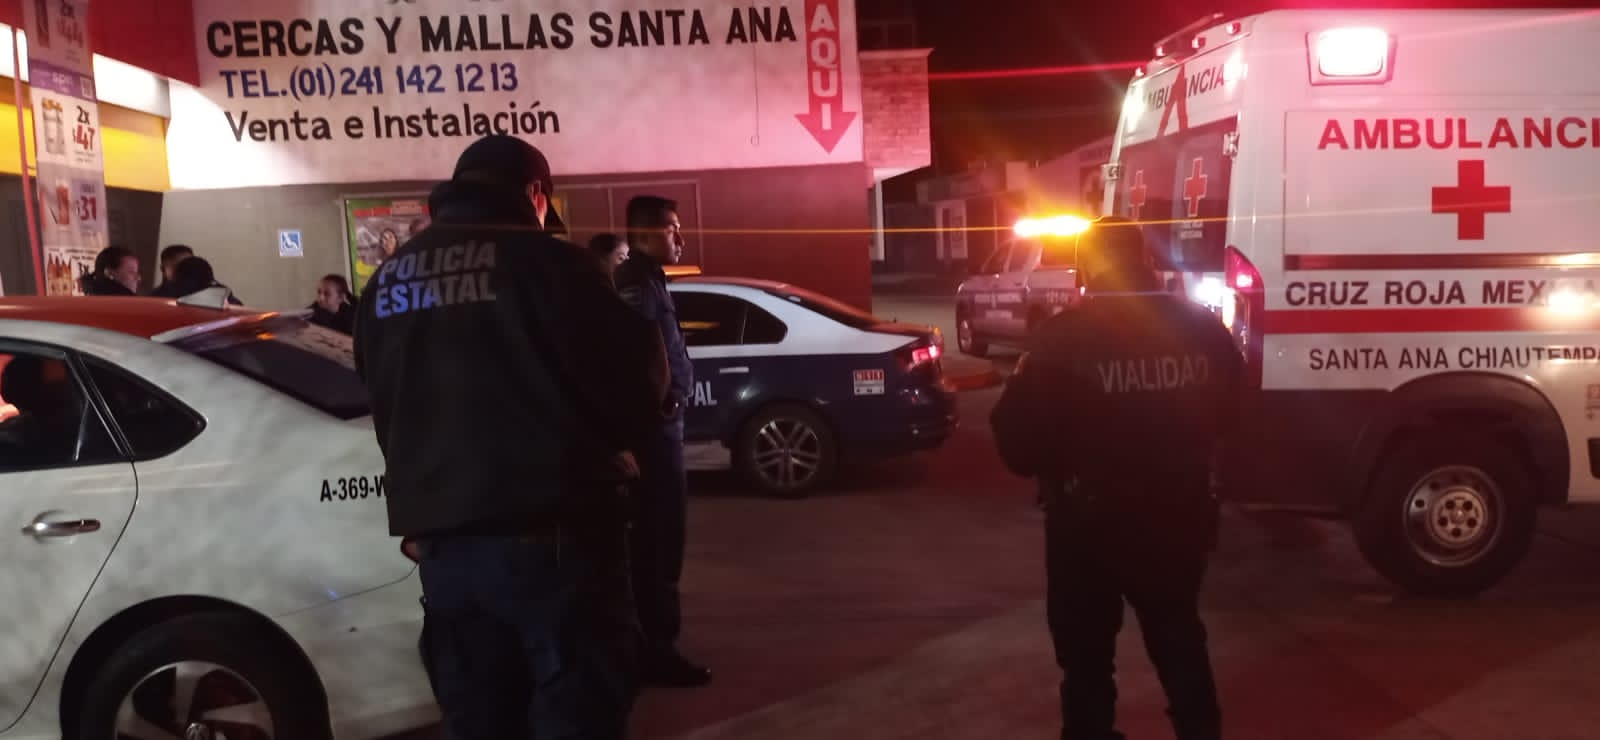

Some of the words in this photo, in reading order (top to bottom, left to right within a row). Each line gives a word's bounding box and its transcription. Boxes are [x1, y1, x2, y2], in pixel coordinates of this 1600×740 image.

[206, 18, 365, 58] CERCAS
[376, 16, 402, 54] Y
[419, 12, 574, 52] MALLAS
[588, 9, 711, 49] SANTA
[725, 6, 798, 44] ANA
[396, 64, 446, 95] 142
[810, 3, 839, 131] AQUI
[224, 110, 333, 142] Venta
[343, 115, 364, 139] e
[372, 101, 560, 139] Instalación
[1317, 117, 1600, 150] AMBULANCI
[375, 271, 497, 319] ESTATAL
[1285, 281, 1369, 306] CRUZ
[1384, 280, 1466, 306] ROJA
[1309, 347, 1389, 371] SANTA
[1398, 347, 1449, 370] ANA
[1458, 346, 1600, 369] CHIAUTEMP
